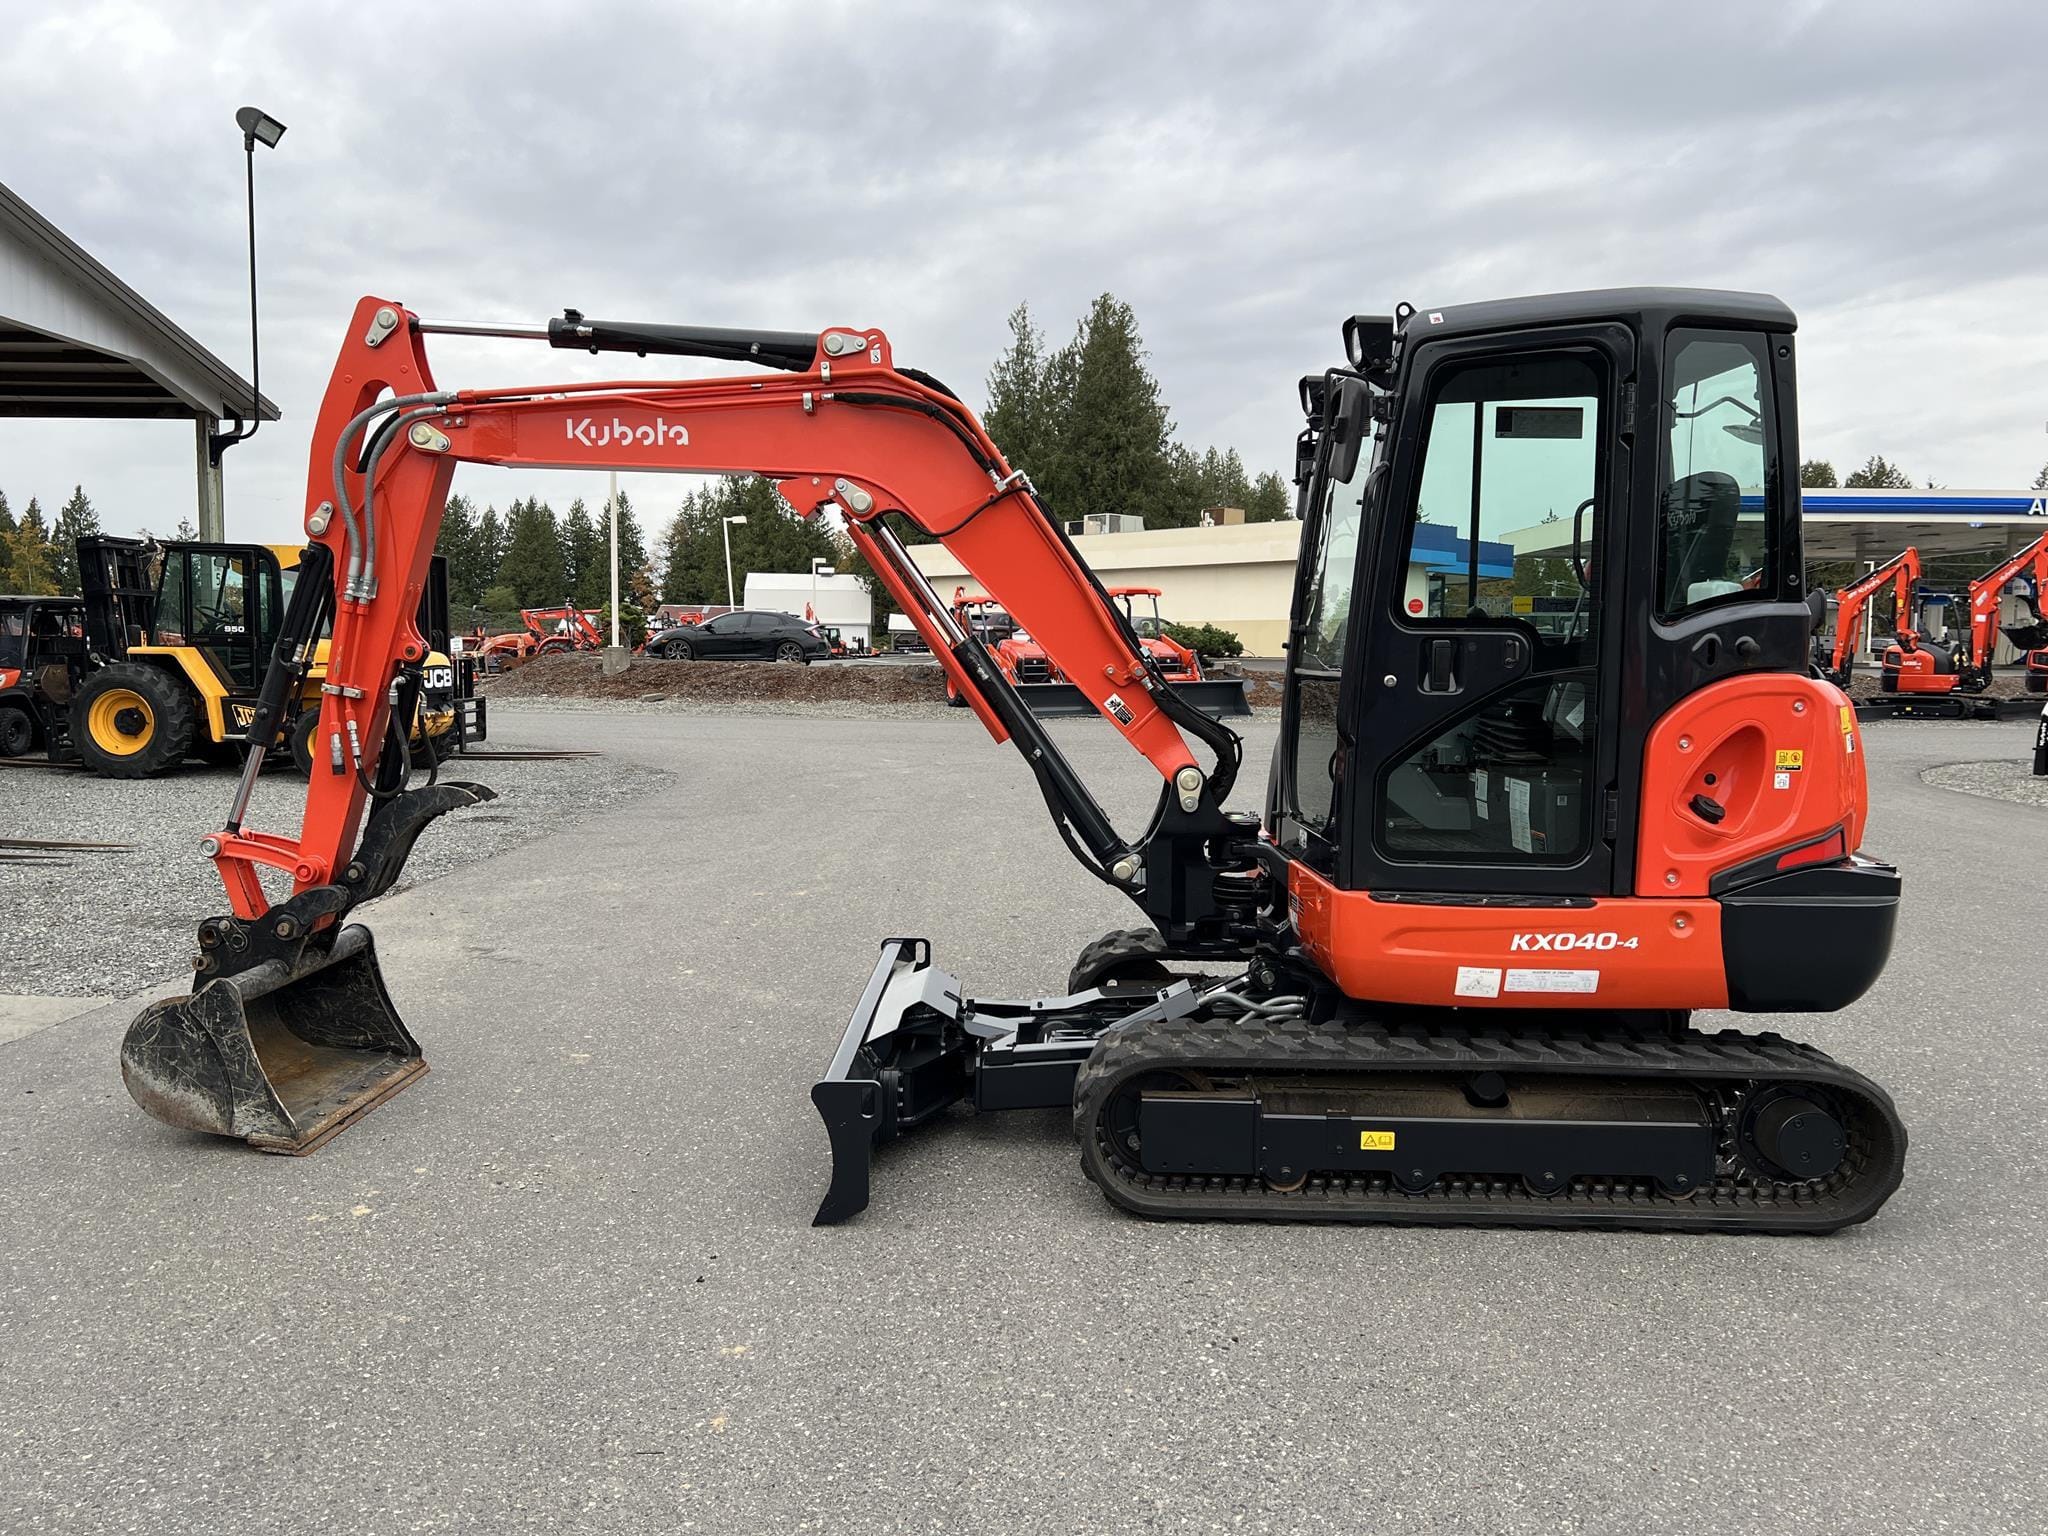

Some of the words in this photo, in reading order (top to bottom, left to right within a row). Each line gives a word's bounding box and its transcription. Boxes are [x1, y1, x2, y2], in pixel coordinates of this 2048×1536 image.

[566, 417, 689, 446] Kubota
[224, 625, 245, 633] 950
[423, 669, 452, 688] JCB
[1510, 932, 1639, 951] KX040-4
